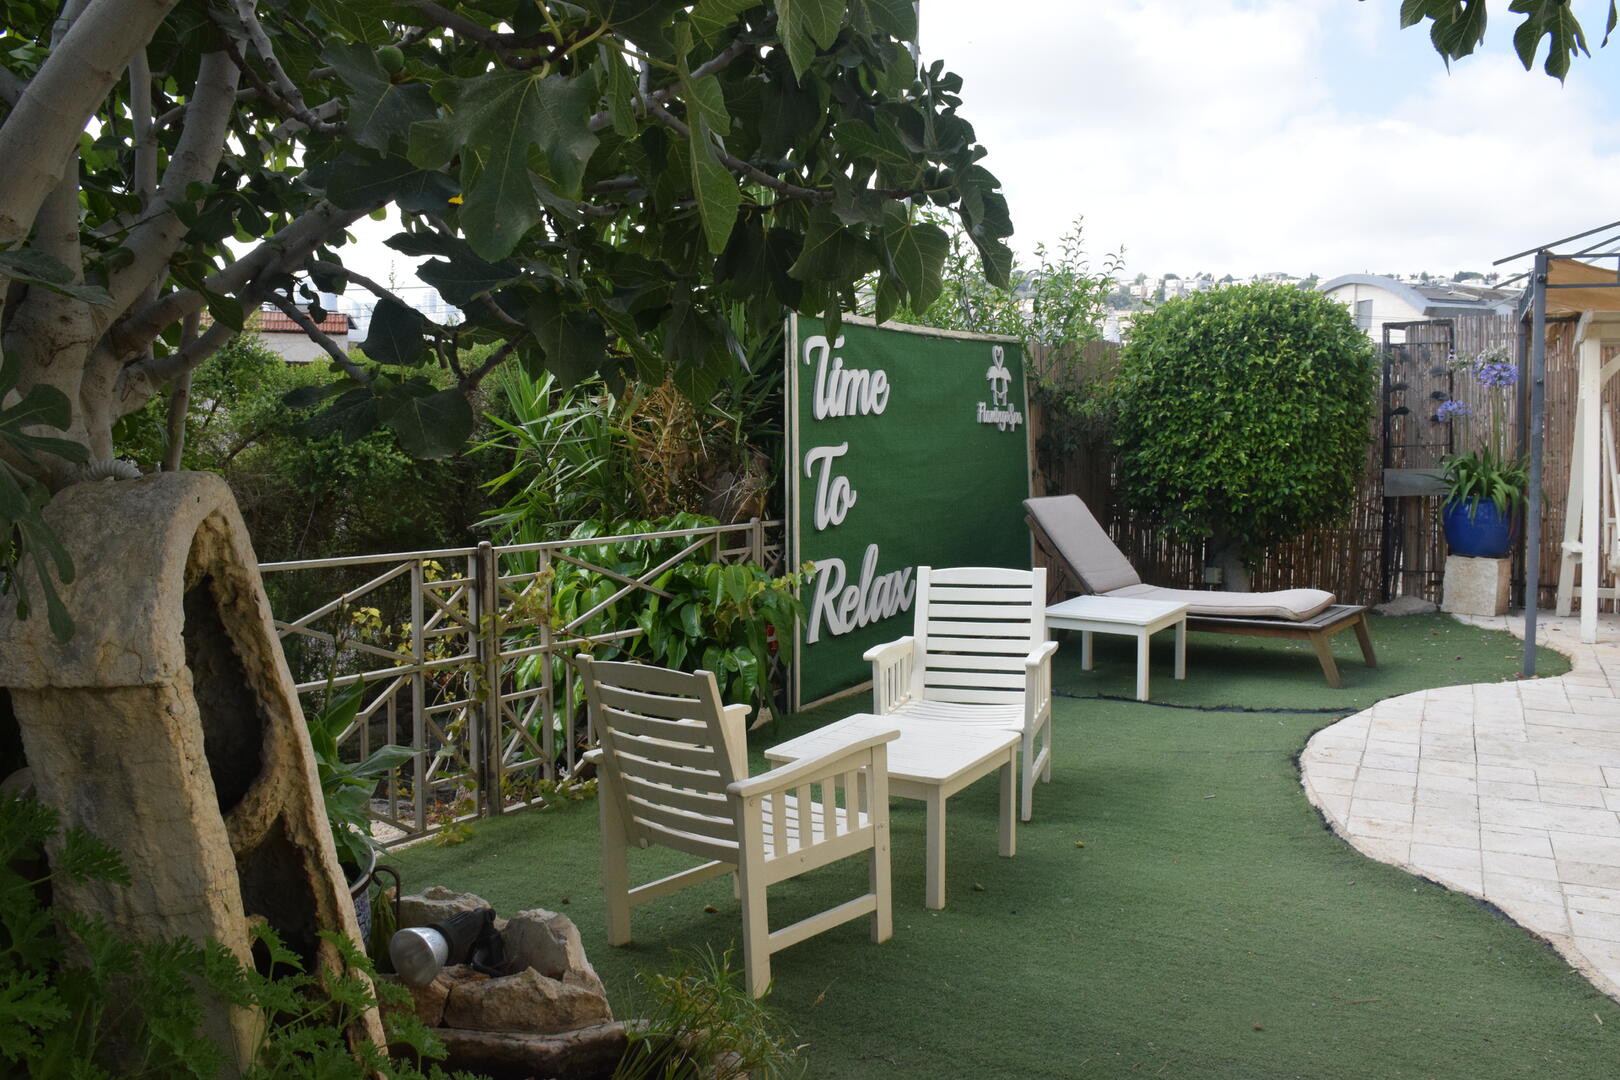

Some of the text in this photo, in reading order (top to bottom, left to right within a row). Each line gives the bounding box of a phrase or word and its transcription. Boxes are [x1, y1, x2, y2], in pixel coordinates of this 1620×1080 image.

[802, 334, 889, 421] Time
[803, 441, 857, 531] To
[806, 543, 916, 644] Relax
